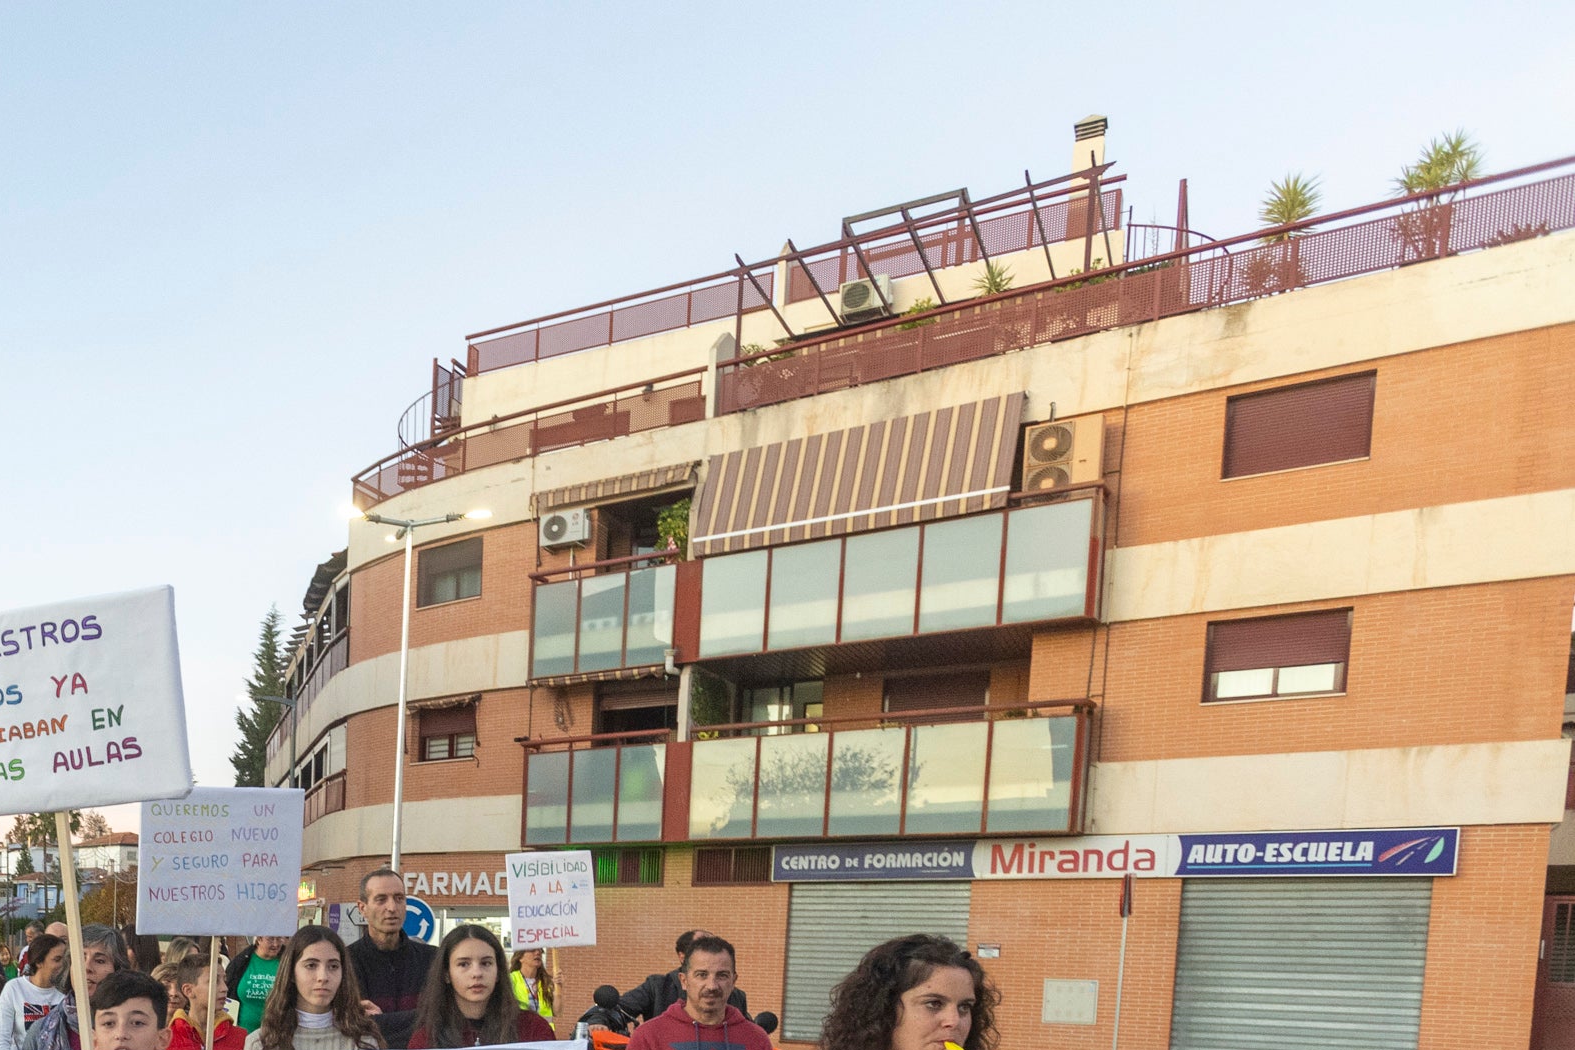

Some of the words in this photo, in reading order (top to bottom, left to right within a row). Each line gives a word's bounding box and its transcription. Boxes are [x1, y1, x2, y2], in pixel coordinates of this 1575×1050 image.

[50, 672, 89, 698] YA
[91, 704, 124, 731] EN
[53, 736, 143, 774] AULAS
[151, 803, 230, 817] QUEREMOS
[254, 803, 275, 817] UN
[153, 830, 214, 844] COLEGIO
[231, 827, 279, 842] NUEVO
[151, 856, 164, 872] Y
[173, 854, 229, 871] SEGURO
[242, 853, 278, 868] PARA
[781, 855, 840, 870] CENTRO
[845, 857, 859, 868] DE
[863, 847, 965, 869] FORMACIÓN
[990, 839, 1156, 874] Miranda
[1187, 840, 1374, 865] AUTO-ESCUELA
[149, 884, 226, 902] NUESTROS
[530, 883, 537, 896] A
[548, 880, 563, 894] LA
[517, 899, 578, 918] EDUCACIÓN
